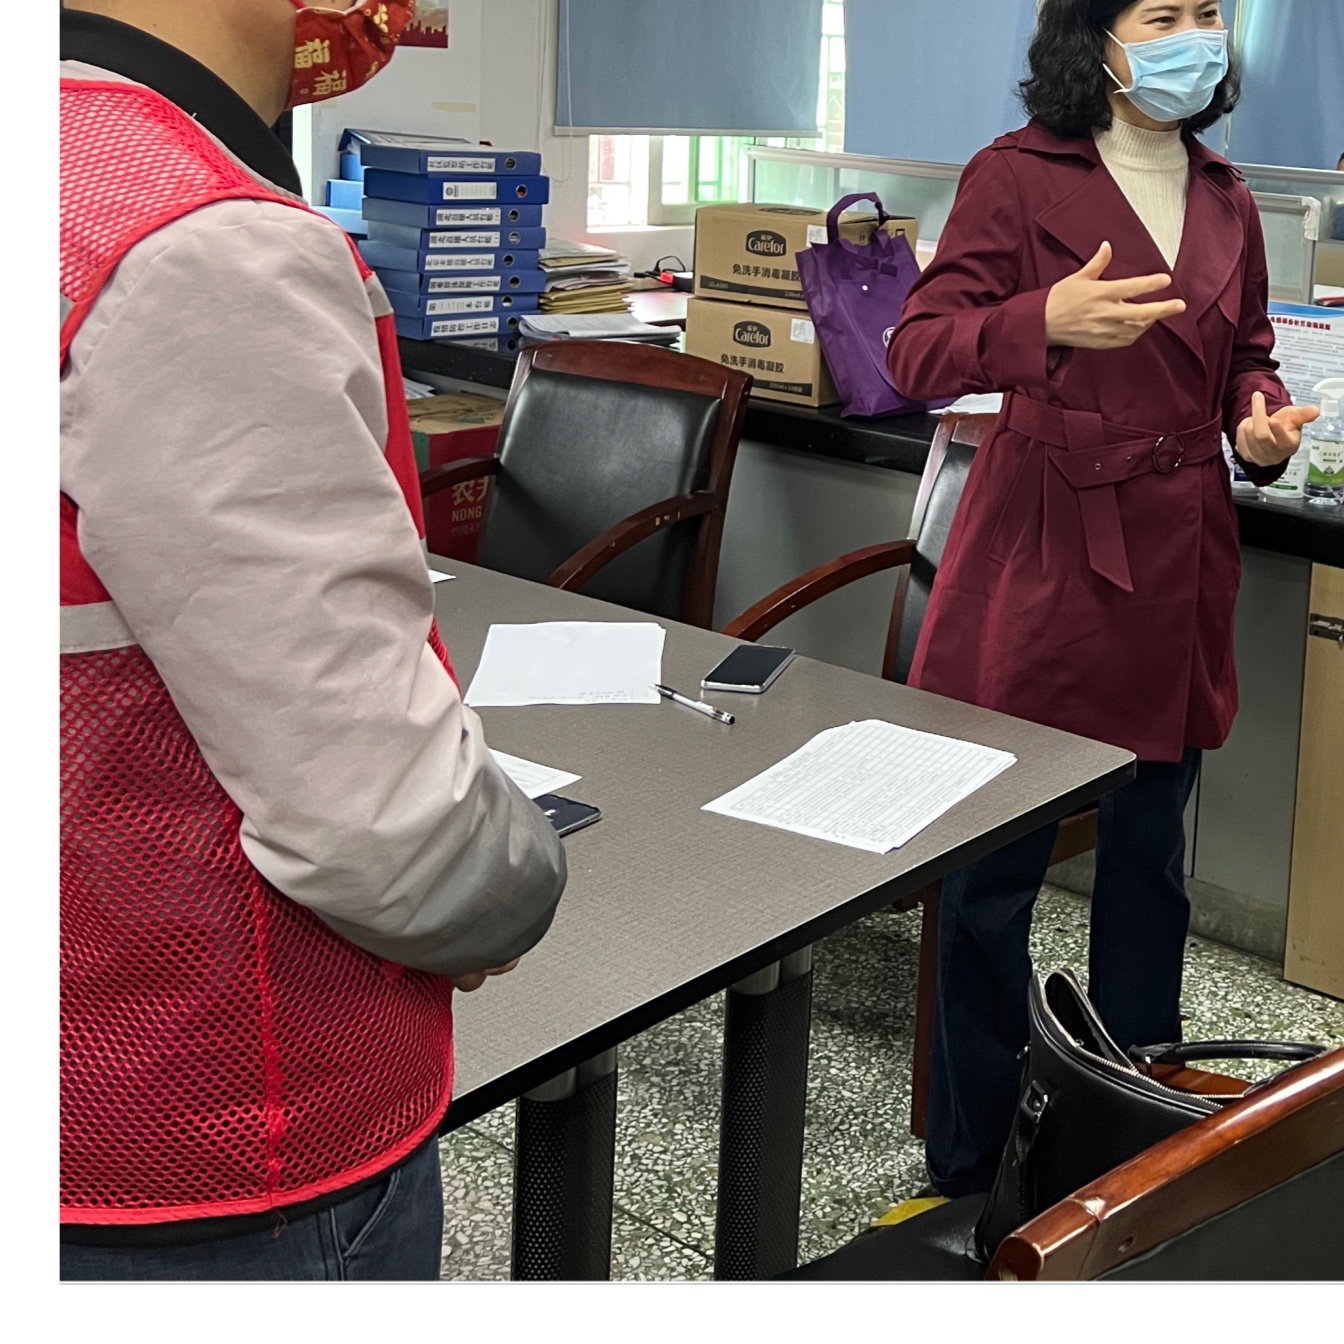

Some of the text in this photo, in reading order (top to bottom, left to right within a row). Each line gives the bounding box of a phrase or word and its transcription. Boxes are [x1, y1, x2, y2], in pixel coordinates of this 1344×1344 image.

[747, 238, 785, 254] Carefor
[734, 328, 770, 345] Carefor
[720, 353, 784, 374] 免洗手消毒凝胶
[452, 506, 482, 522] NONG
